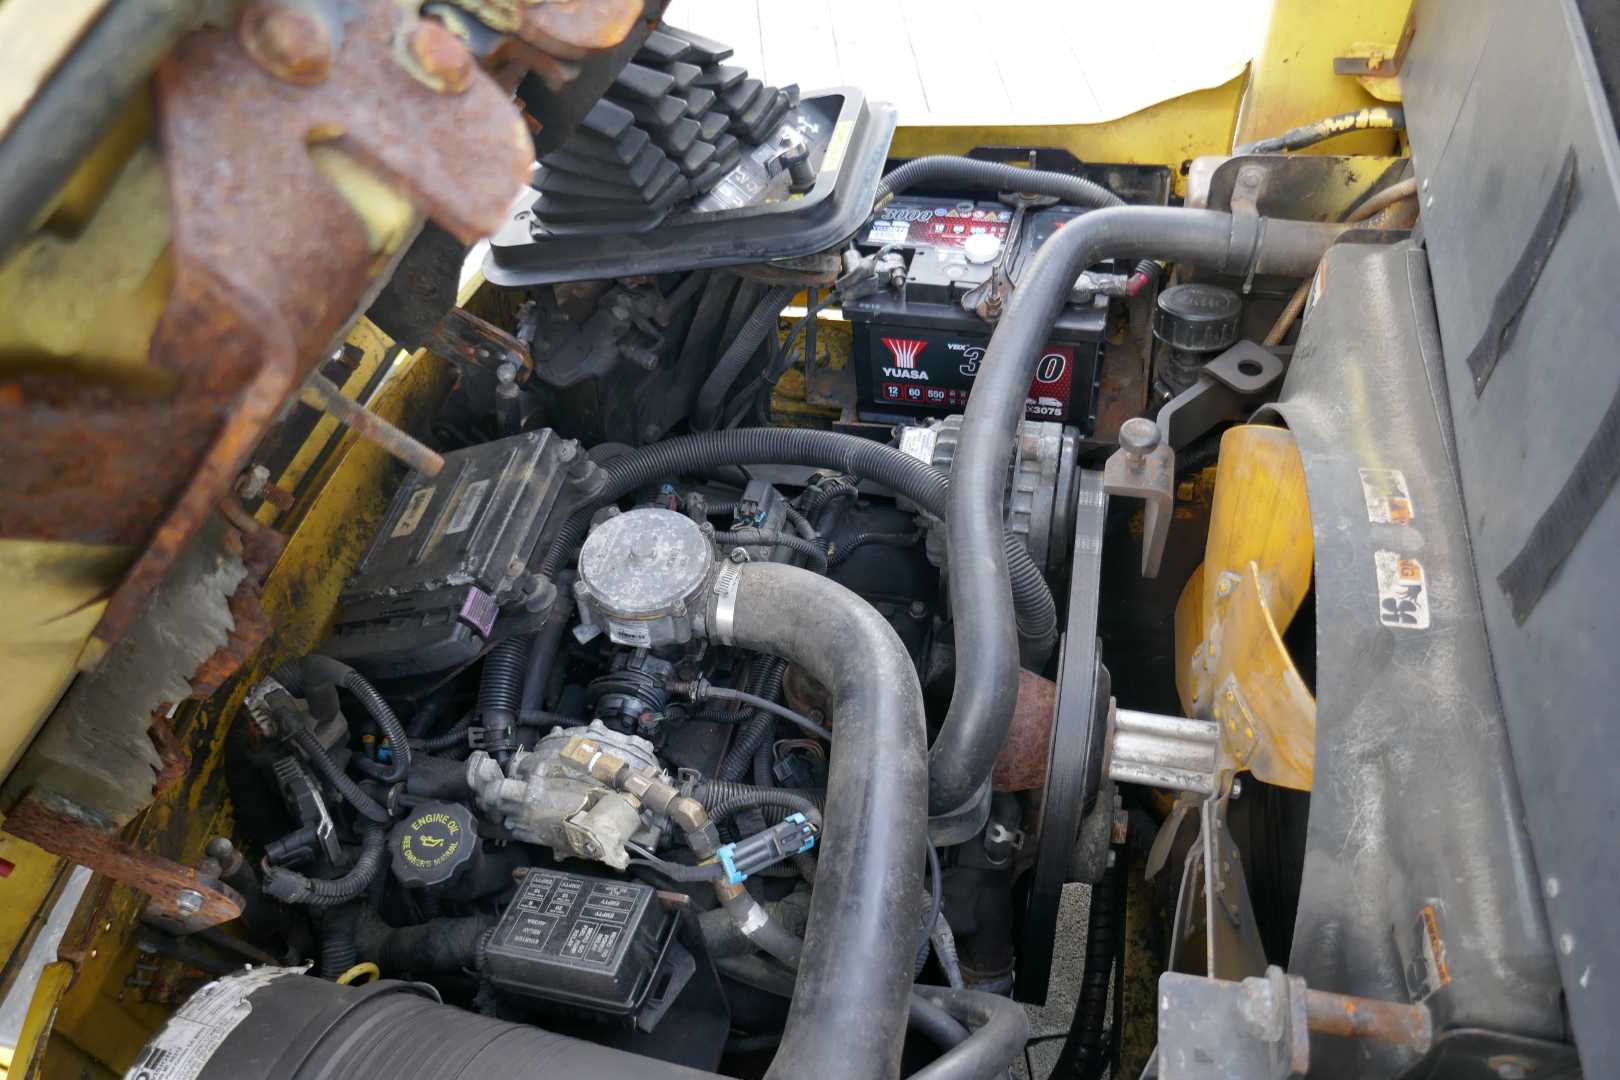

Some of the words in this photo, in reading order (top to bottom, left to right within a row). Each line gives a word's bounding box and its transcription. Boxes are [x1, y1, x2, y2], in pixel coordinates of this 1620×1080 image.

[882, 368, 929, 381] YUASA
[888, 386, 898, 395] 12
[909, 388, 921, 397] 60
[411, 813, 450, 831] ENGINE
[447, 820, 460, 836] OIL
